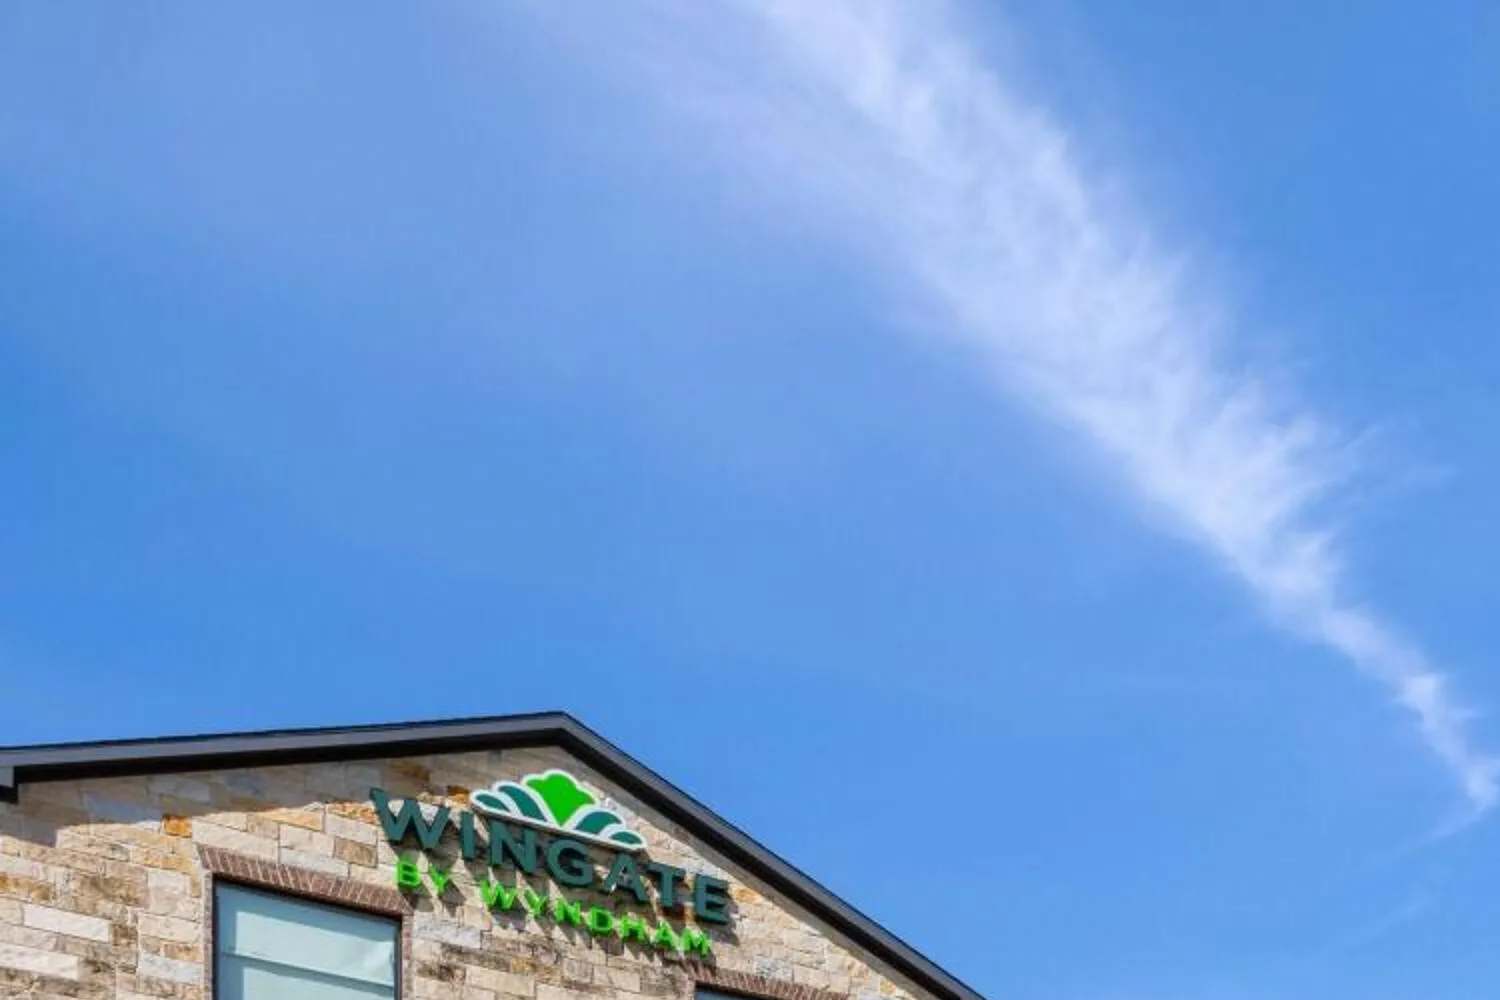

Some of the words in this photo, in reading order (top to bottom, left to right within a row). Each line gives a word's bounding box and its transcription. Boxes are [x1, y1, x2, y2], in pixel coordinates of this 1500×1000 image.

[370, 787, 731, 925] WINGATE
[394, 857, 450, 896] BY
[479, 879, 713, 958] WYNDHAM
